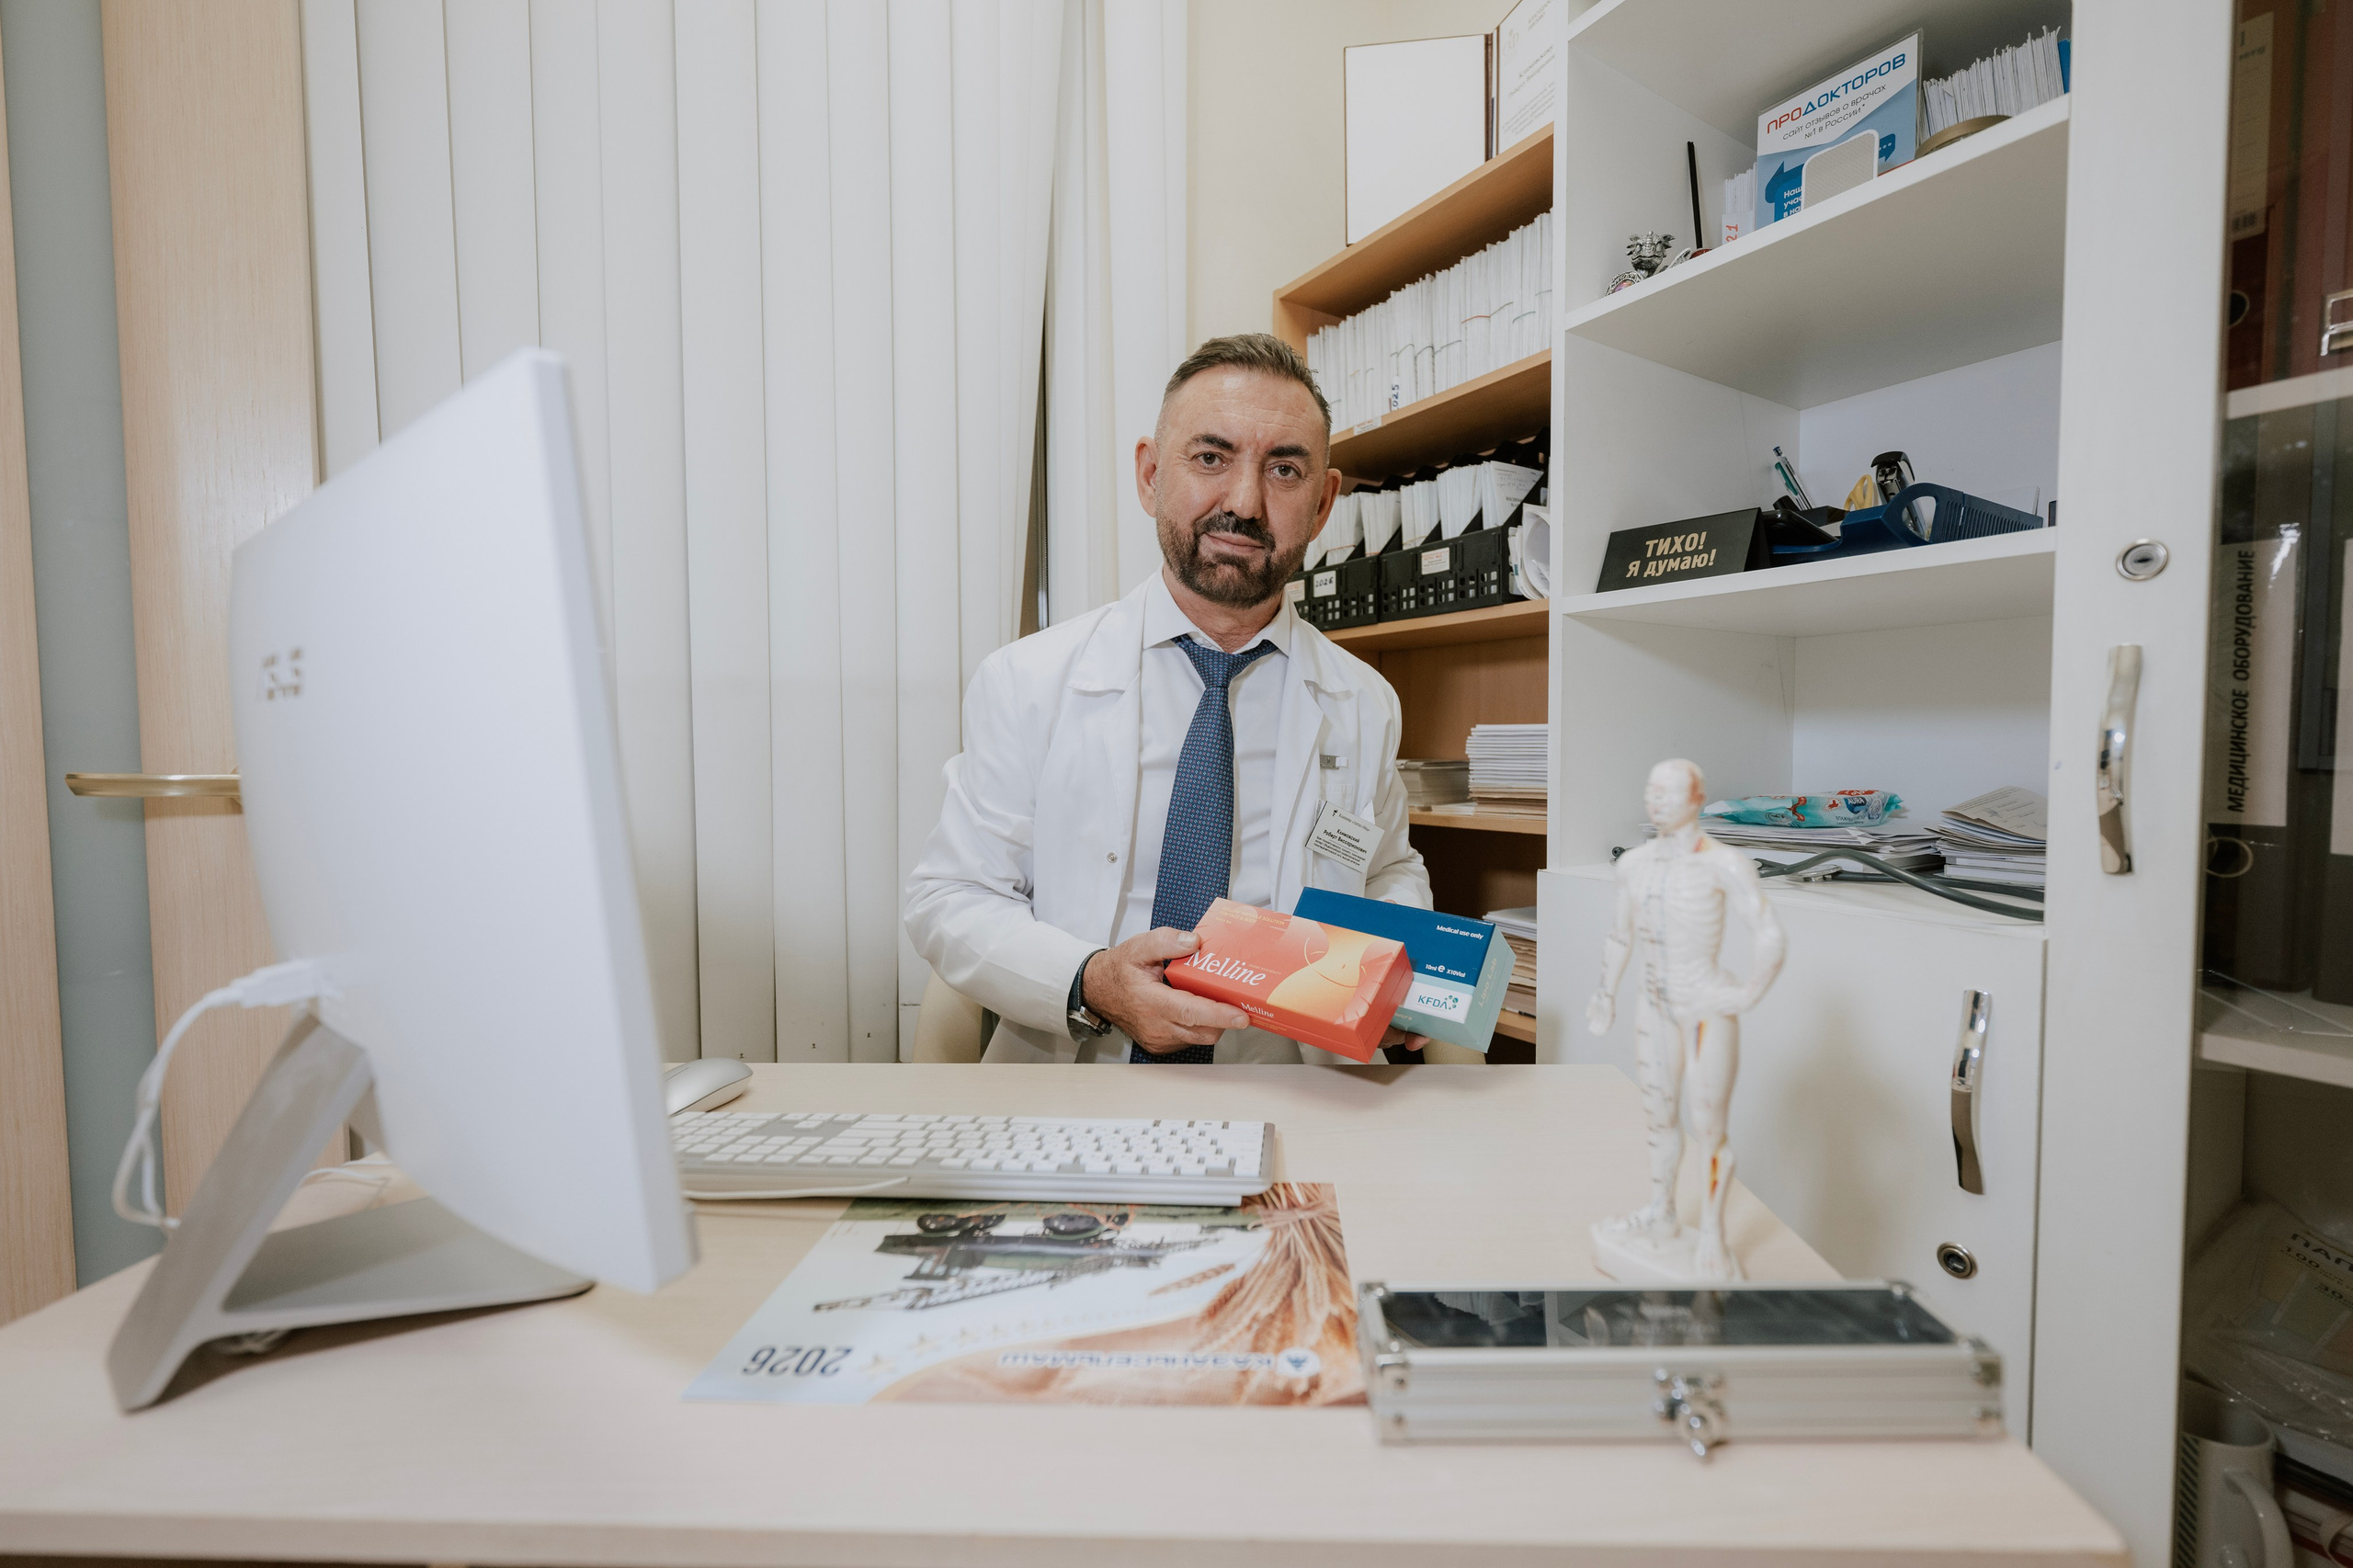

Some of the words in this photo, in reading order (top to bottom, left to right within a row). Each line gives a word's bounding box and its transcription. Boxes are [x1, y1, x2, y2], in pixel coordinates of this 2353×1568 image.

[1767, 52, 1906, 134] ПРОДОКТОРОВ
[1781, 123, 1804, 141] сайт
[1804, 108, 1841, 131] отзывов
[1842, 102, 1849, 111] о
[1850, 83, 1887, 108] врачах
[1803, 127, 1818, 140] №1
[1818, 125, 1824, 133] в
[1391, 382, 1401, 411] 025
[1645, 530, 1708, 558] ТИХО!
[1625, 560, 1642, 578] Я
[1643, 548, 1717, 578] думаю!
[2233, 550, 2256, 681] ОБОРУДОВАНИЕ
[2227, 689, 2250, 813] МЕДИЦИНСКОЕ
[1847, 797, 1866, 805] AURA
[1437, 925, 1460, 935] Medical
[1470, 932, 1484, 940] only
[1183, 949, 1267, 986] Melline
[1240, 1002, 1275, 1018] Melline
[1417, 994, 1448, 1010] KFDA
[741, 1346, 854, 1378] 2026
[997, 1350, 1276, 1371] КАЗАНЬСЕЛЬМАШ
